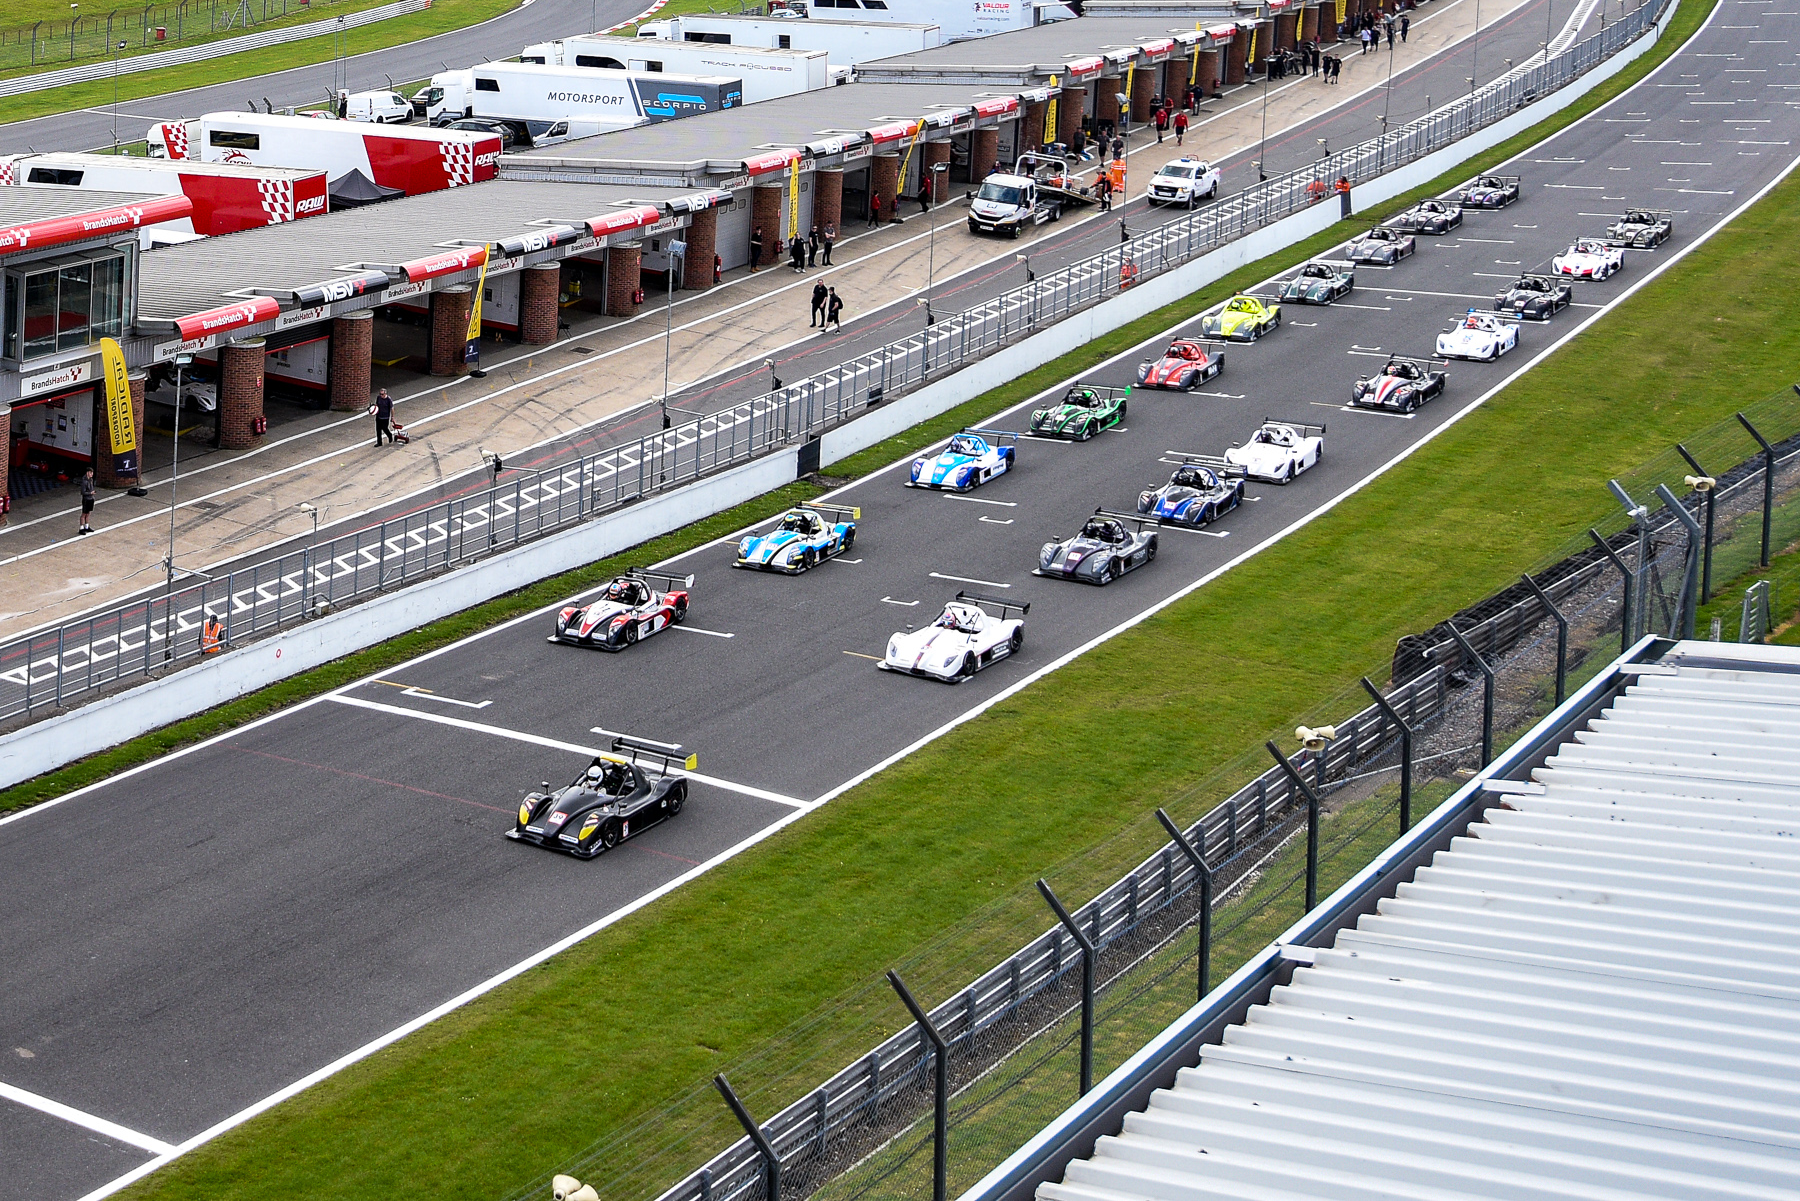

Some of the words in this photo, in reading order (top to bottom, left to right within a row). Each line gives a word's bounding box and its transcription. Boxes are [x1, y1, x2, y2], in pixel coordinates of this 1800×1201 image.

[547, 91, 624, 106] MOTORSPORT
[642, 98, 706, 111] SCORPIO
[474, 151, 500, 166] RAW
[296, 195, 325, 213] RAW
[685, 195, 710, 212] MSV
[83, 213, 128, 231] BrandsHatch
[519, 233, 547, 253] MSV
[424, 257, 458, 274] BrandsHatch
[319, 280, 354, 303] MSV
[201, 311, 243, 330] BrandsHatch
[283, 309, 314, 326] BrandsHatch
[162, 340, 198, 357] BrandsHatch
[31, 373, 70, 391] BrandsHatch
